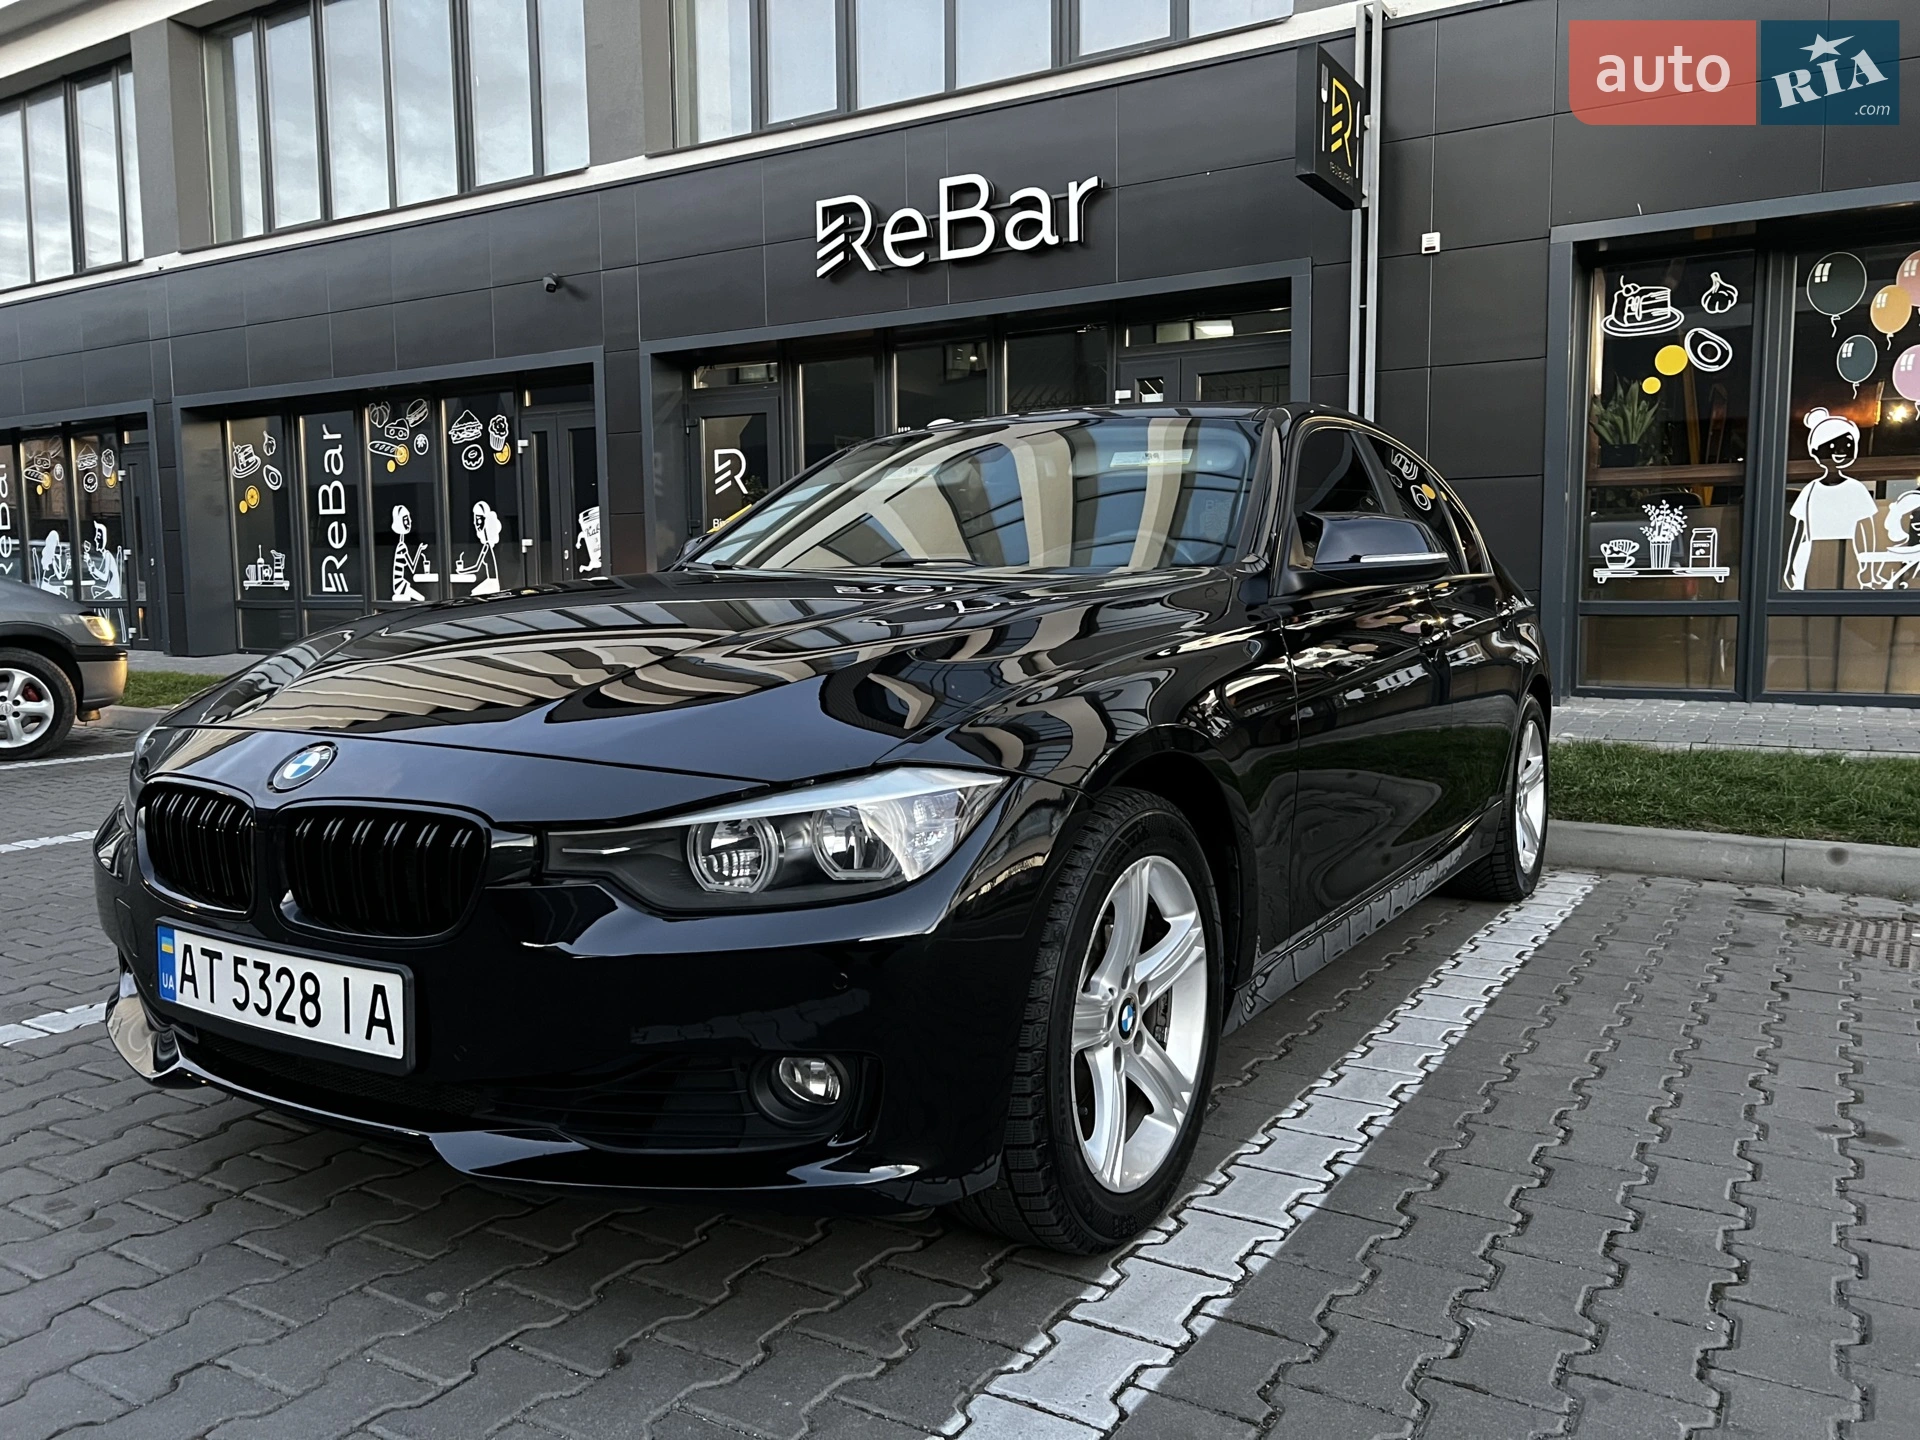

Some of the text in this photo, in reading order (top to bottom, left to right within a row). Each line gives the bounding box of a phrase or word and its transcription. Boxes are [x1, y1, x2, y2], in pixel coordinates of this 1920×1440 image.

[815, 173, 1102, 279] ReBar
[318, 423, 349, 593] ReBar
[162, 971, 175, 990] UA
[179, 944, 396, 1045] AT 5328 IA
